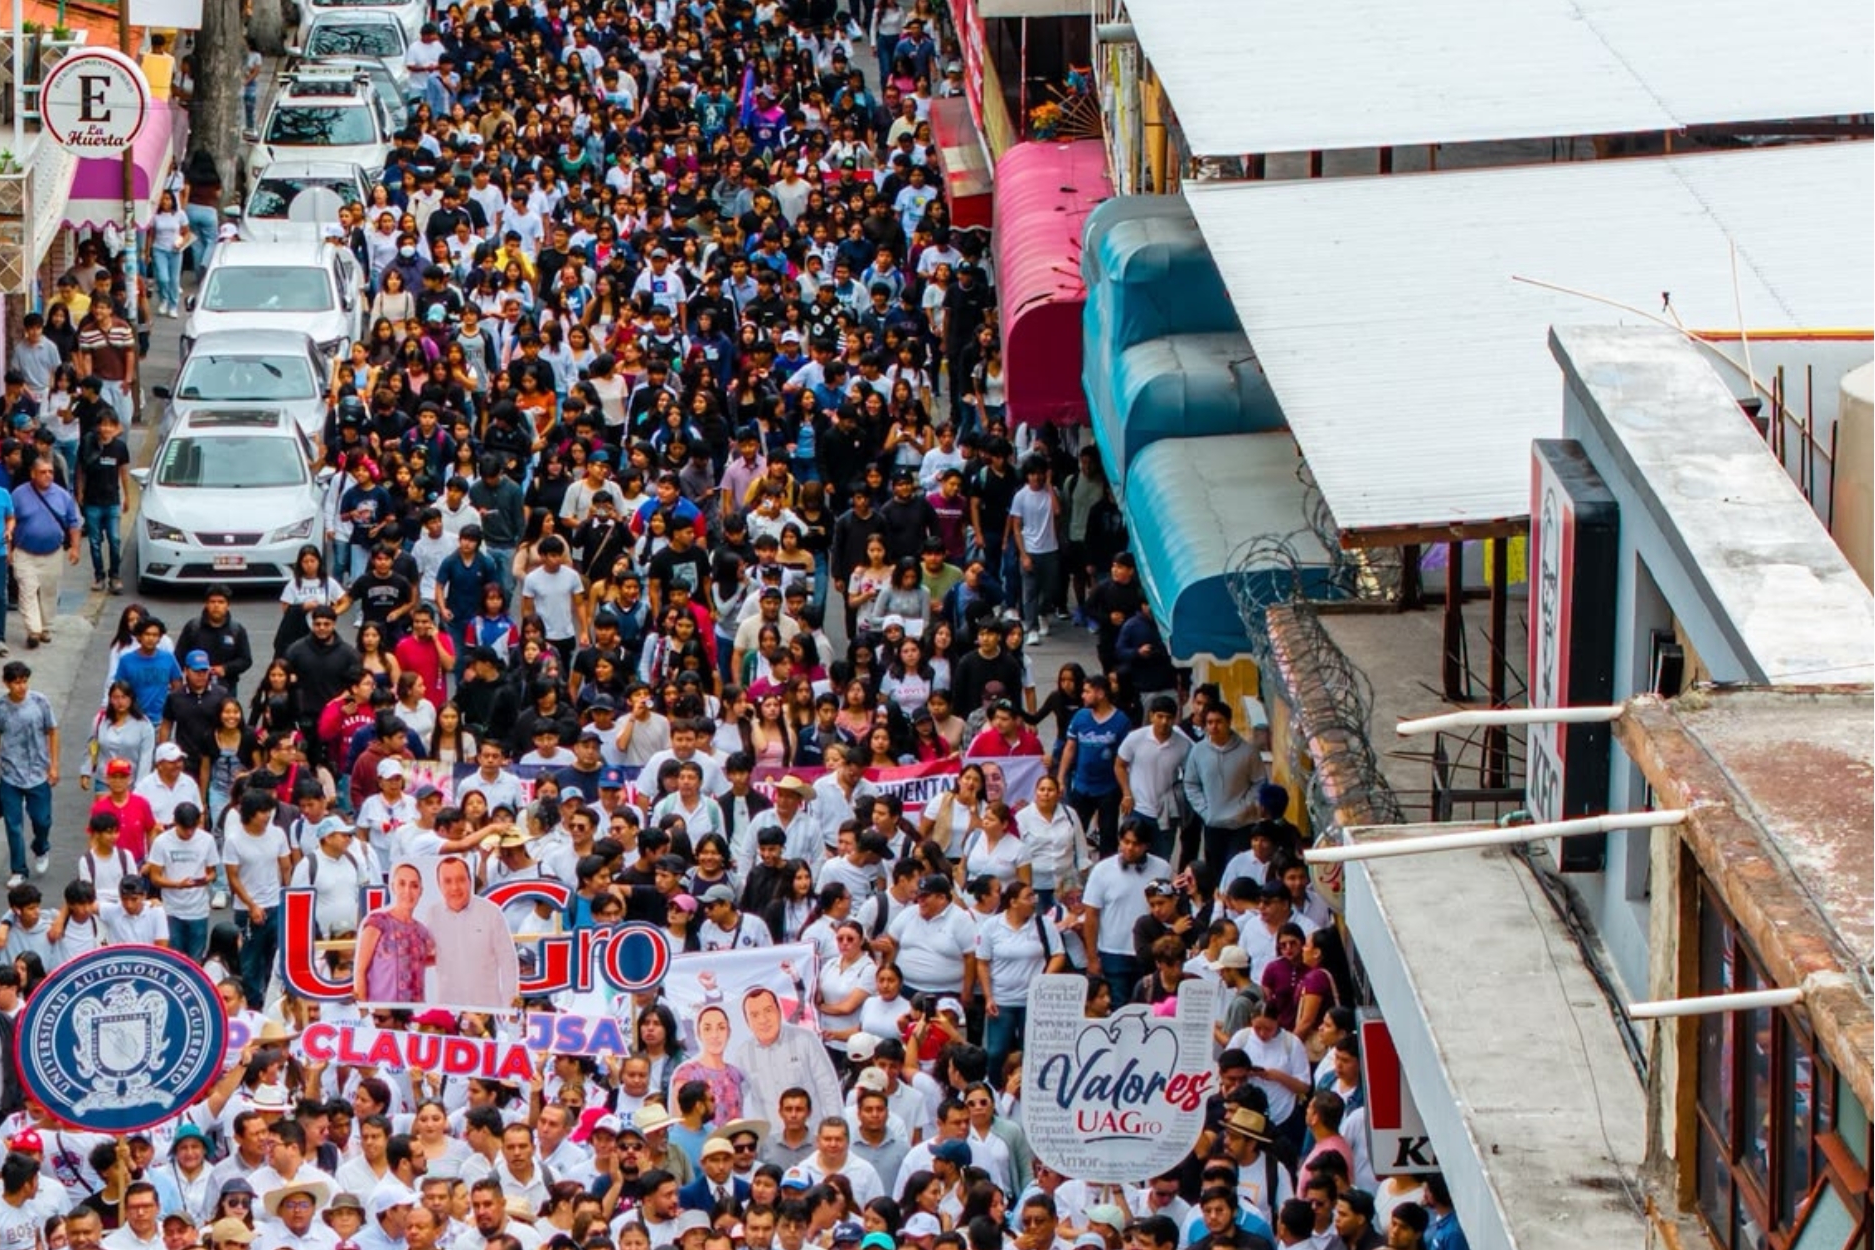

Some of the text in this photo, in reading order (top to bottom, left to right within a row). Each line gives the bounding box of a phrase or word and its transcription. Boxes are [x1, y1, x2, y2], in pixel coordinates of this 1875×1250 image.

[78, 75, 111, 122] E
[66, 131, 124, 147] Huerta
[74, 963, 169, 991] AUTÓNOMA
[174, 981, 192, 1001] DE
[39, 993, 71, 1094] UNIVERSIDAD
[170, 1006, 204, 1085] GUERRERO
[301, 1022, 535, 1081] CLAUDIA
[527, 1012, 627, 1055] JSA
[1038, 1048, 1213, 1112] Valores
[1077, 1109, 1162, 1135] UAGro
